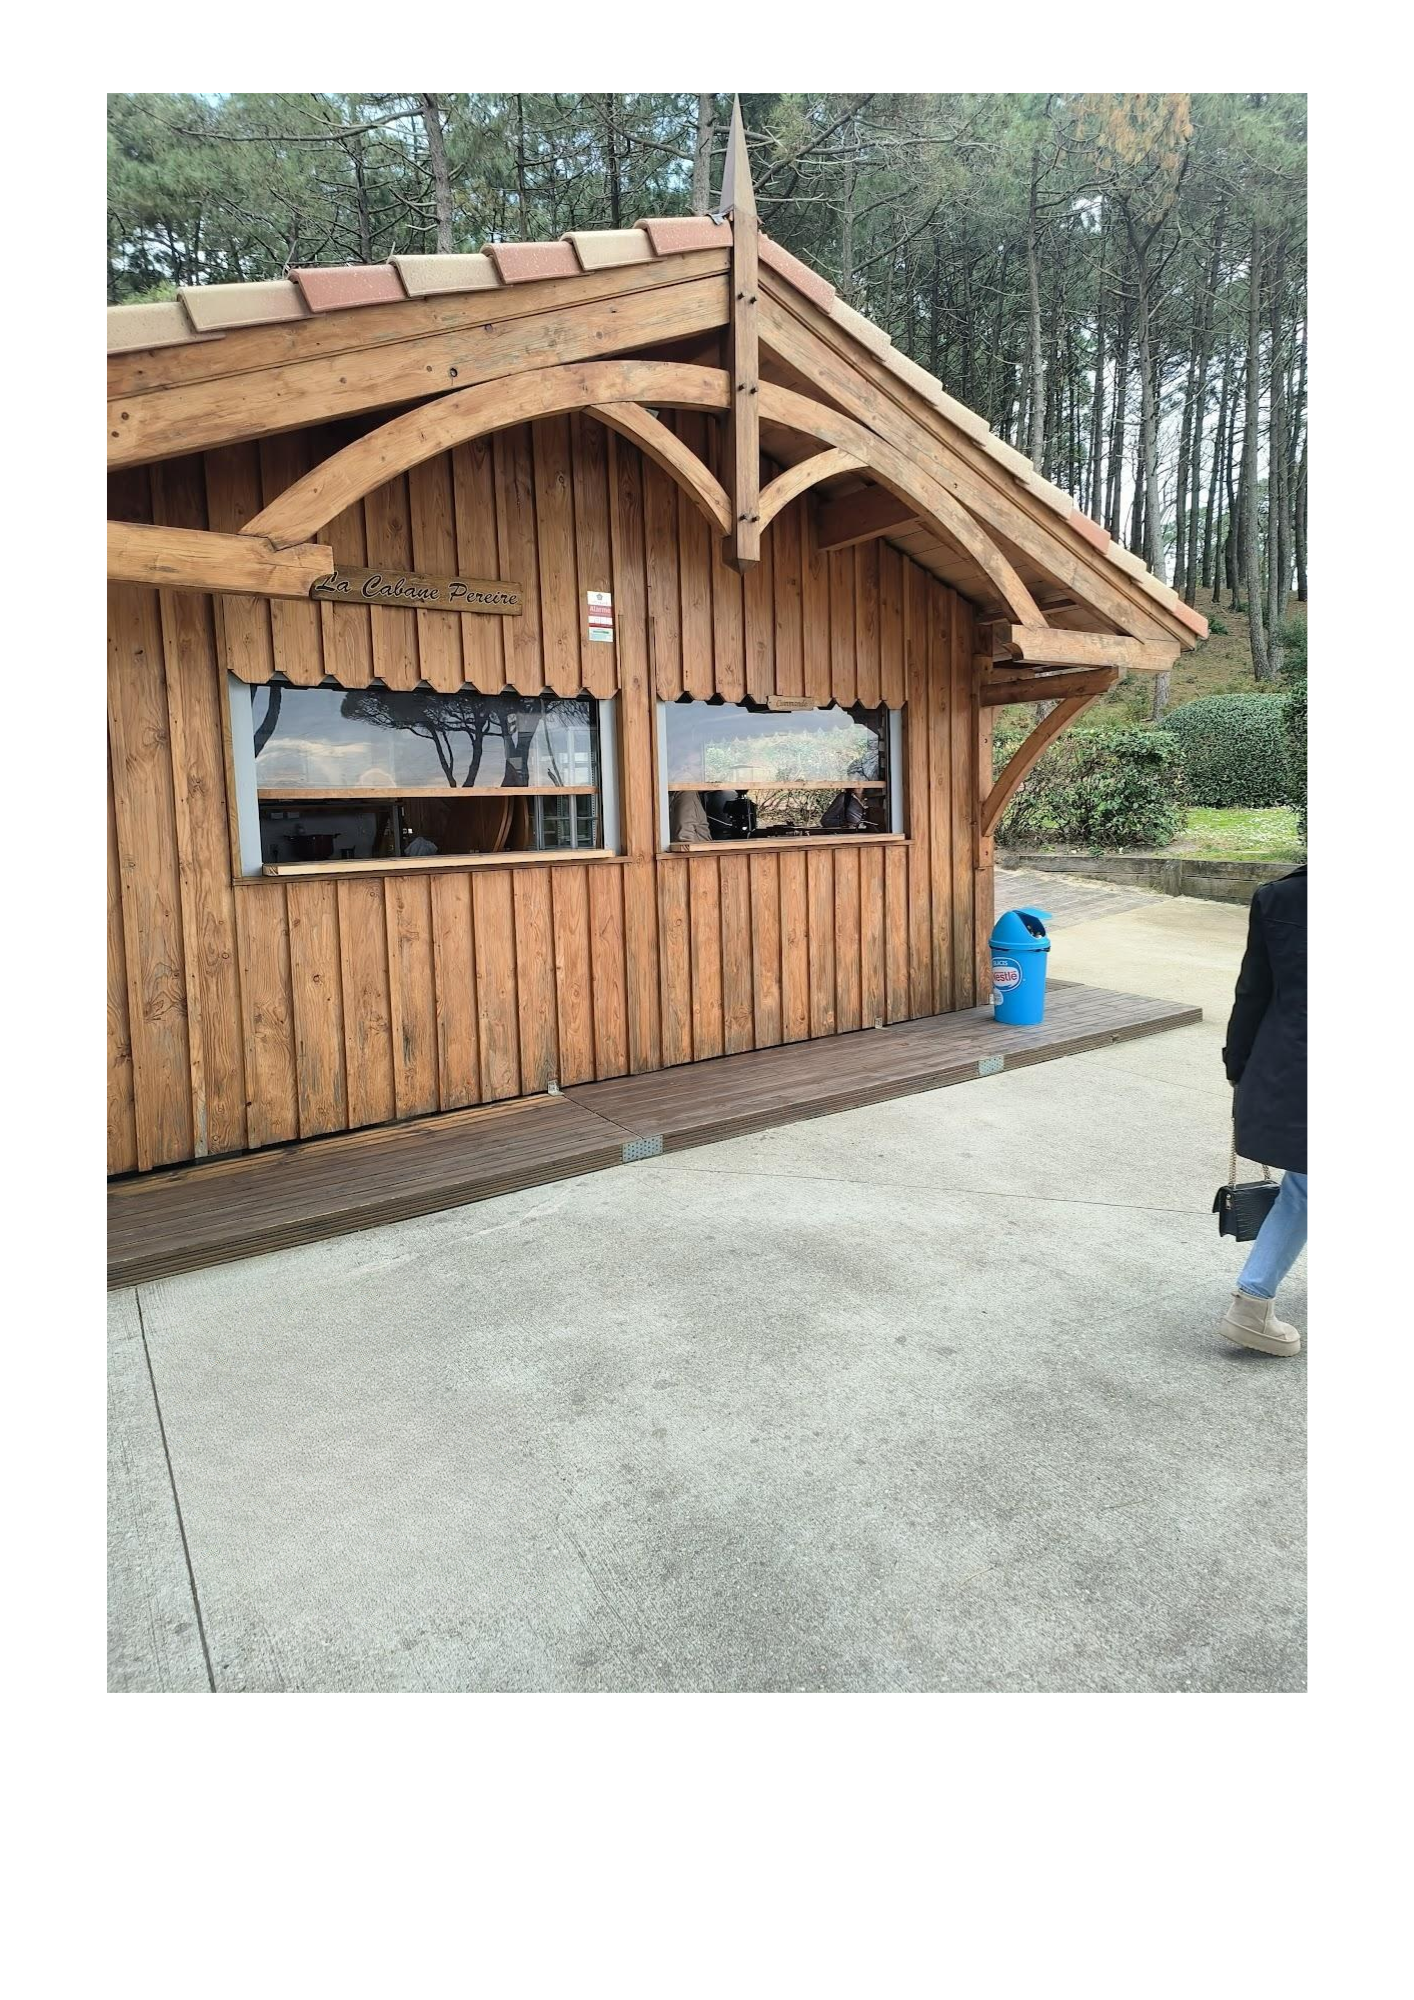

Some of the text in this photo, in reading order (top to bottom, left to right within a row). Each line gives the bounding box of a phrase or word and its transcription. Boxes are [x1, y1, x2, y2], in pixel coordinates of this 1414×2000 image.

[316, 571, 518, 605] La Cabane Pereire
